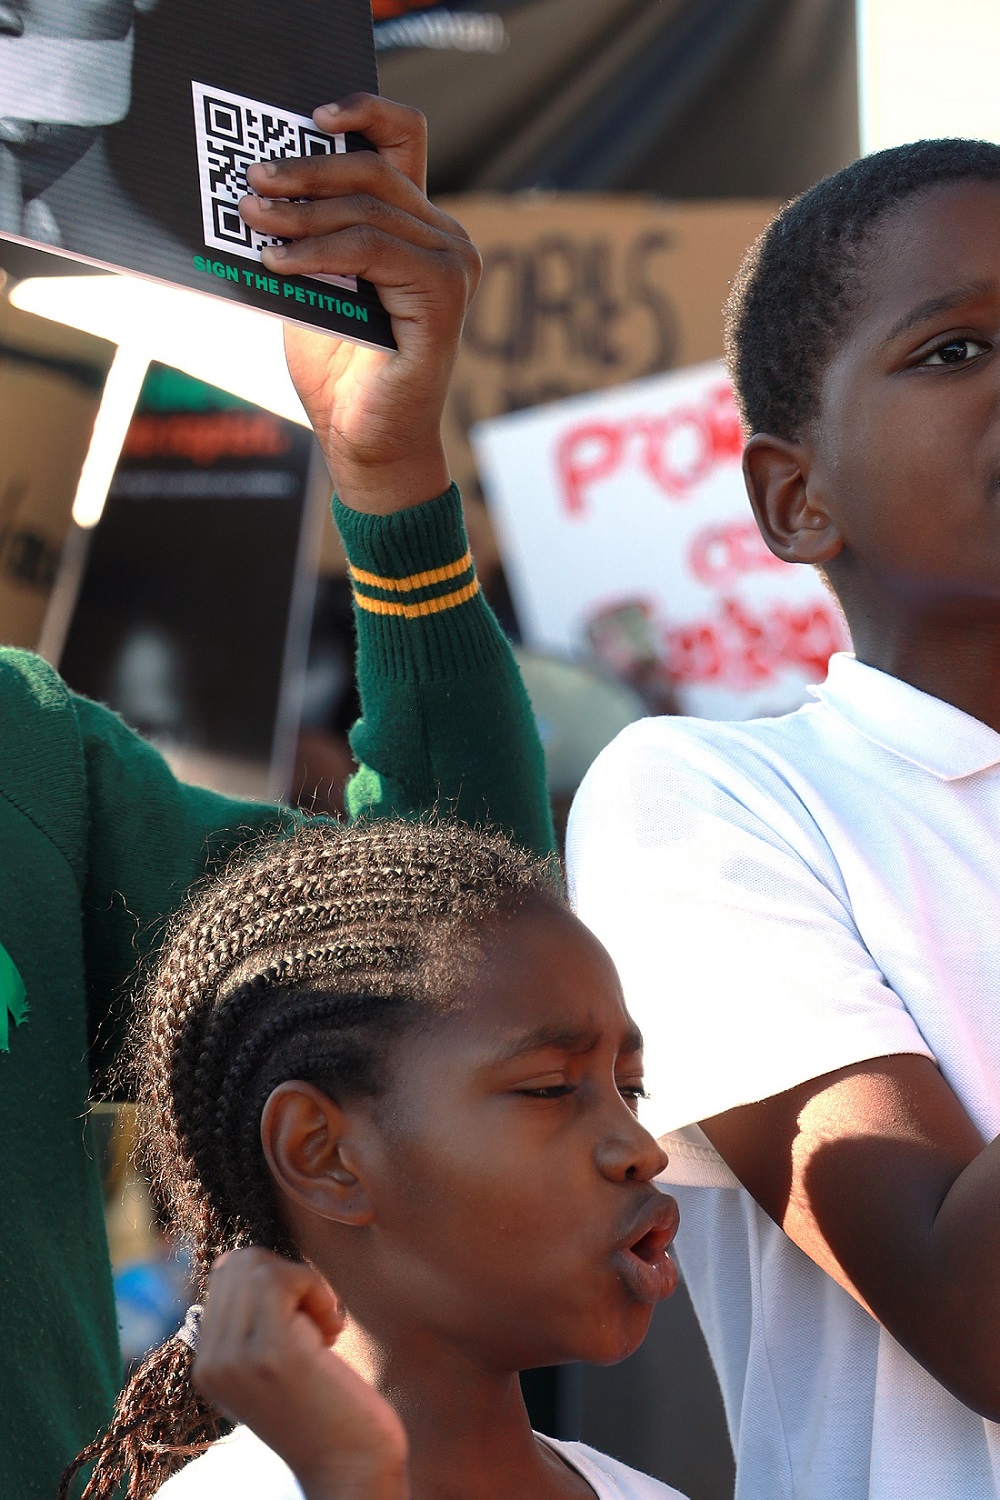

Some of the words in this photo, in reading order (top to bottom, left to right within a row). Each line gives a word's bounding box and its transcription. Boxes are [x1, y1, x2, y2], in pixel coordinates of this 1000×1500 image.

[193, 255, 239, 283] SIGN
[242, 269, 280, 296] THE
[283, 282, 369, 323] PETITION
